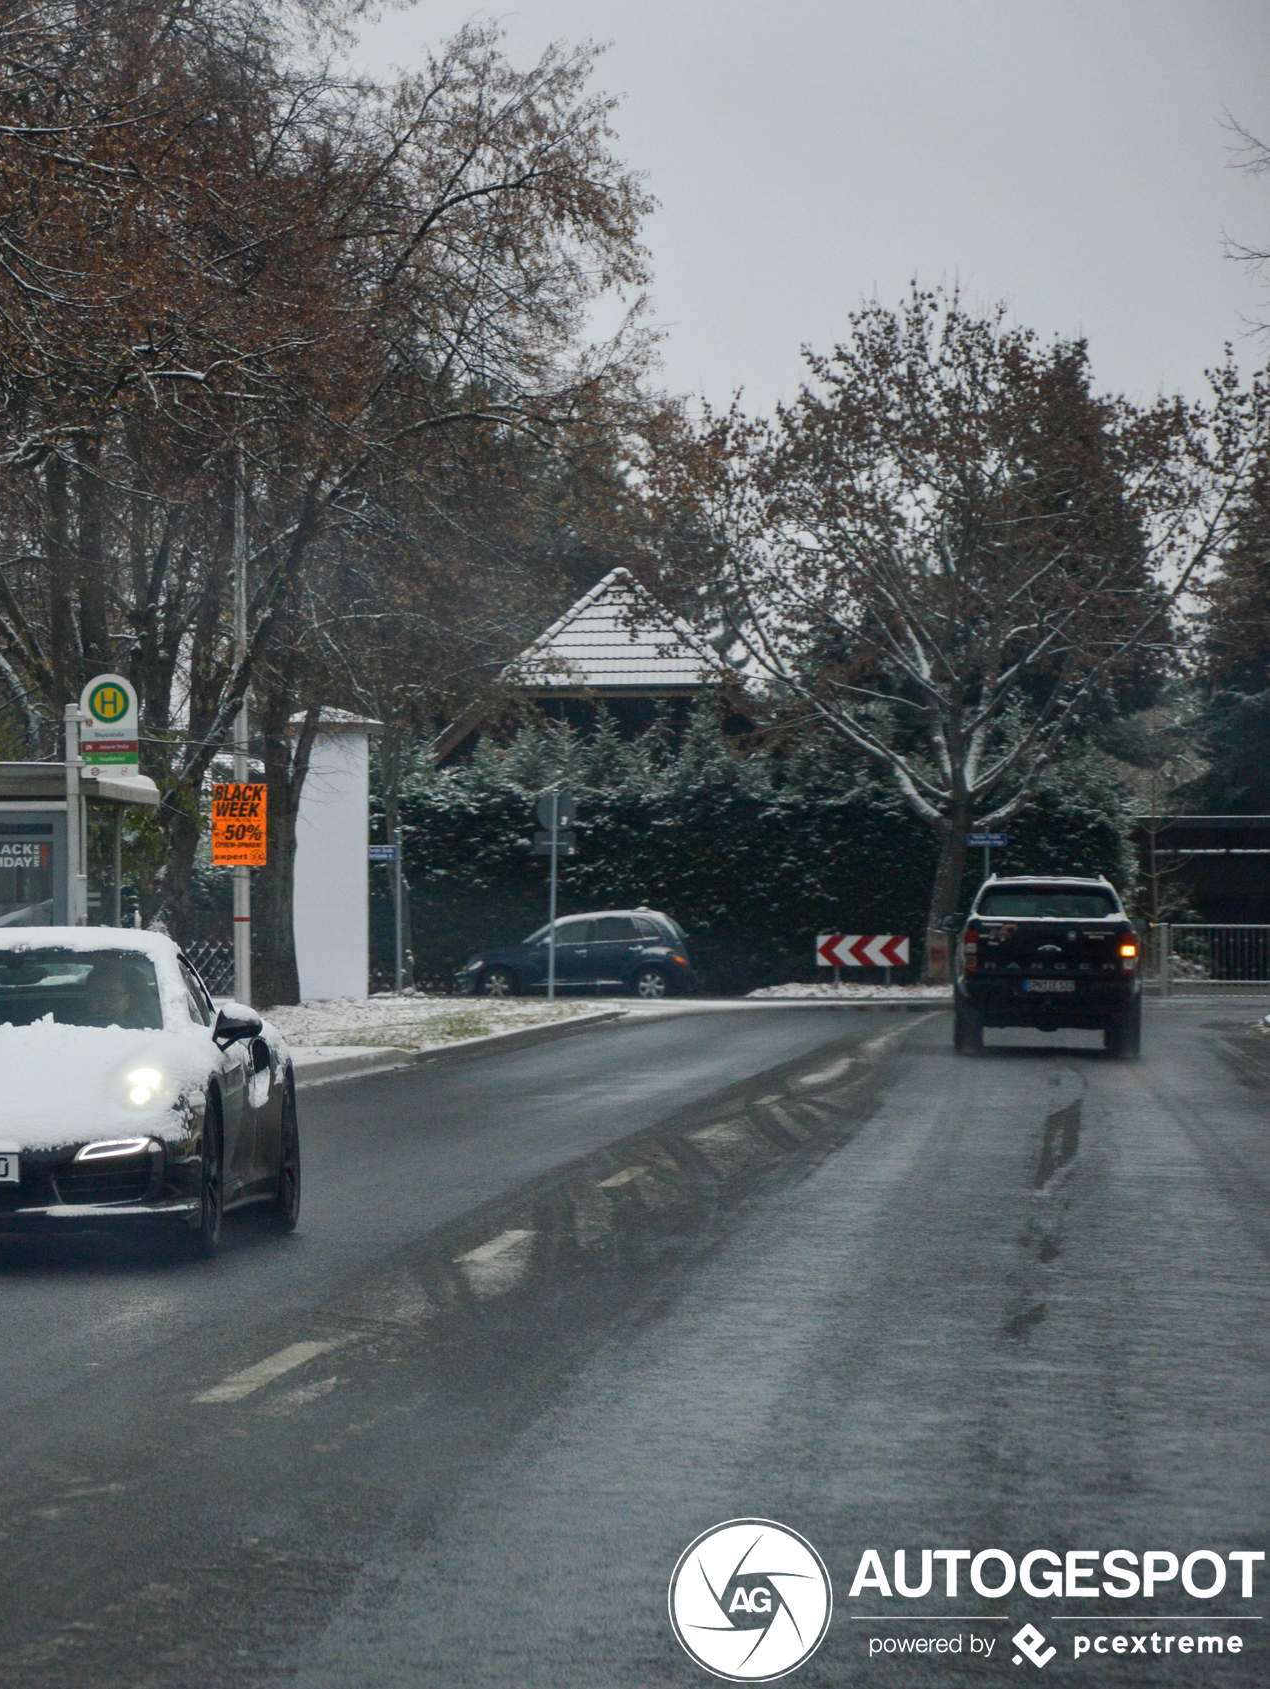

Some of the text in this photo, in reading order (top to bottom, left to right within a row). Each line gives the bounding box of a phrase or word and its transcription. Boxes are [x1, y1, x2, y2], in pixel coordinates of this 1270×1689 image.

[101, 691, 117, 714] H
[215, 785, 264, 801] BLACK
[216, 801, 260, 817] WEEK
[225, 824, 262, 841] 50%
